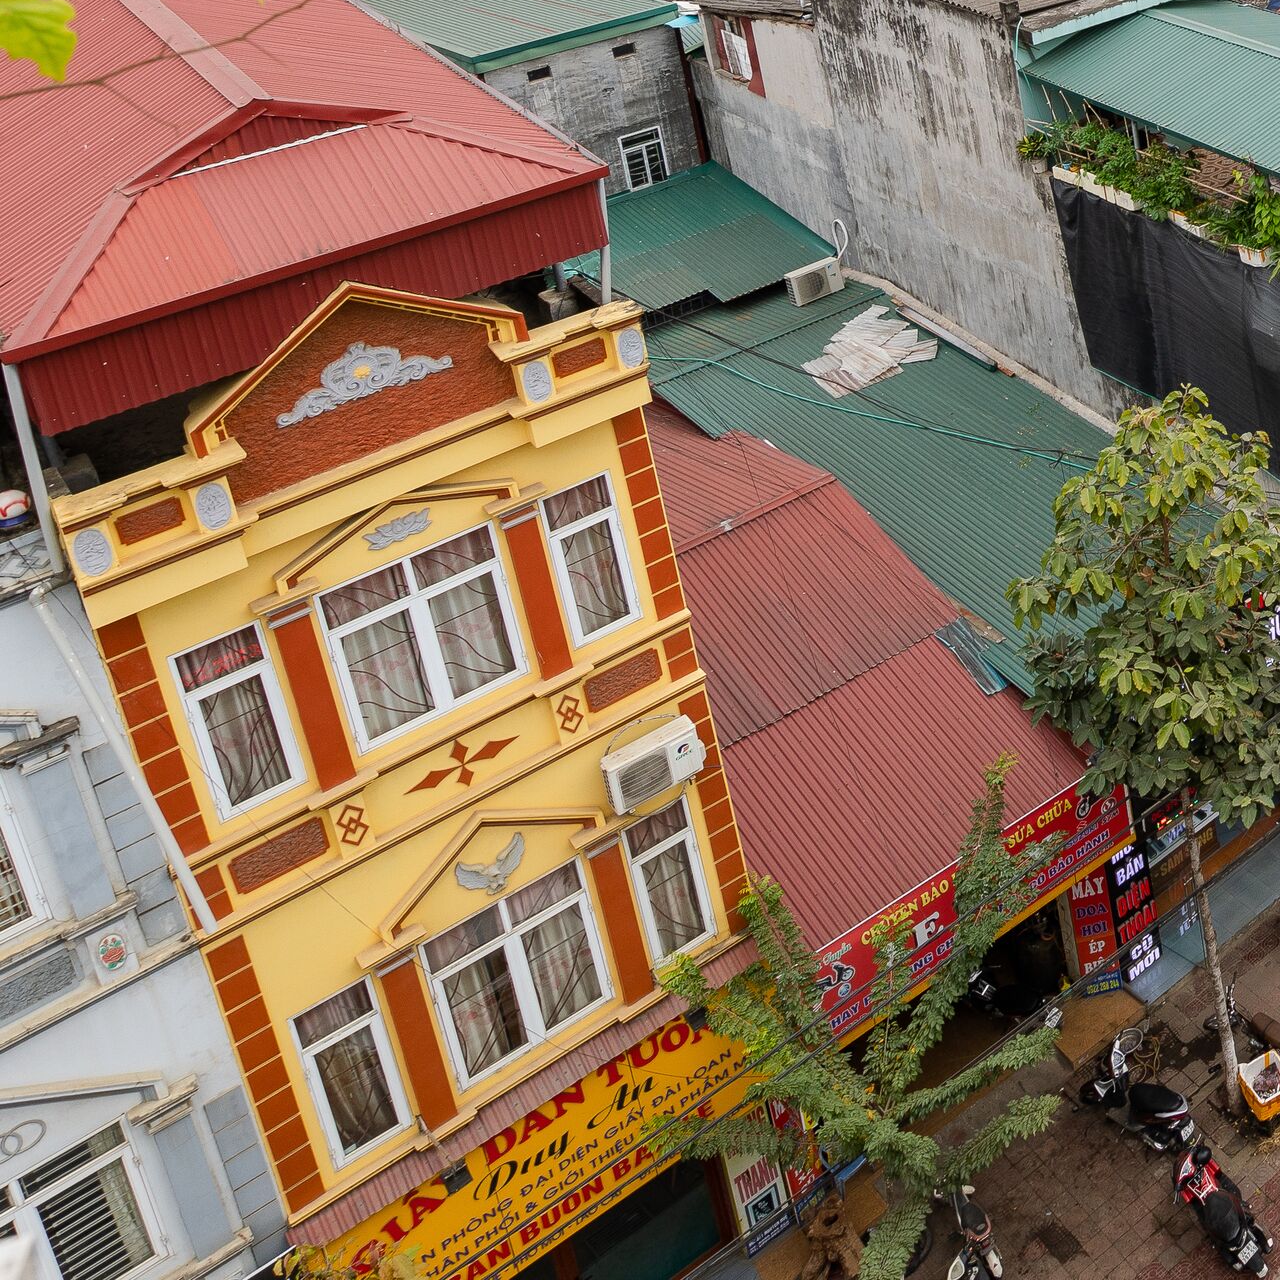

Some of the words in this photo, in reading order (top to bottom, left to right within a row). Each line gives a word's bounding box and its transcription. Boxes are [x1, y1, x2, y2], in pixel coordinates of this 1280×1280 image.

[919, 878, 949, 908] BẢO
[1007, 823, 1036, 849] SỬA
[1036, 797, 1073, 829] CHỮA
[1047, 853, 1074, 881] BẢO
[1075, 827, 1111, 862] HÀNH
[1115, 853, 1145, 887] BÁN
[1160, 853, 1185, 877] SAM
[1071, 875, 1105, 901] MÁY
[1116, 876, 1150, 918] ĐIỆN
[1089, 938, 1106, 955] ÉP
[1128, 946, 1161, 981] MỚI
[1130, 933, 1154, 960] CŨ
[441, 1197, 514, 1251] PHÒNG
[519, 1168, 555, 1198] ĐẠI
[559, 1137, 599, 1173] DIỆN
[603, 1104, 646, 1141] GIẤY
[651, 1082, 683, 1109] ĐÀI
[684, 1047, 733, 1087] LOAN
[473, 1131, 576, 1202] Duy
[586, 1075, 660, 1131] An
[425, 1247, 470, 1280] HÂN
[474, 1209, 521, 1248] PHỐI
[524, 1201, 539, 1213] &
[542, 1166, 586, 1199] GIỚI
[588, 1134, 635, 1171] THIỆU
[679, 1070, 730, 1108] PHẨM
